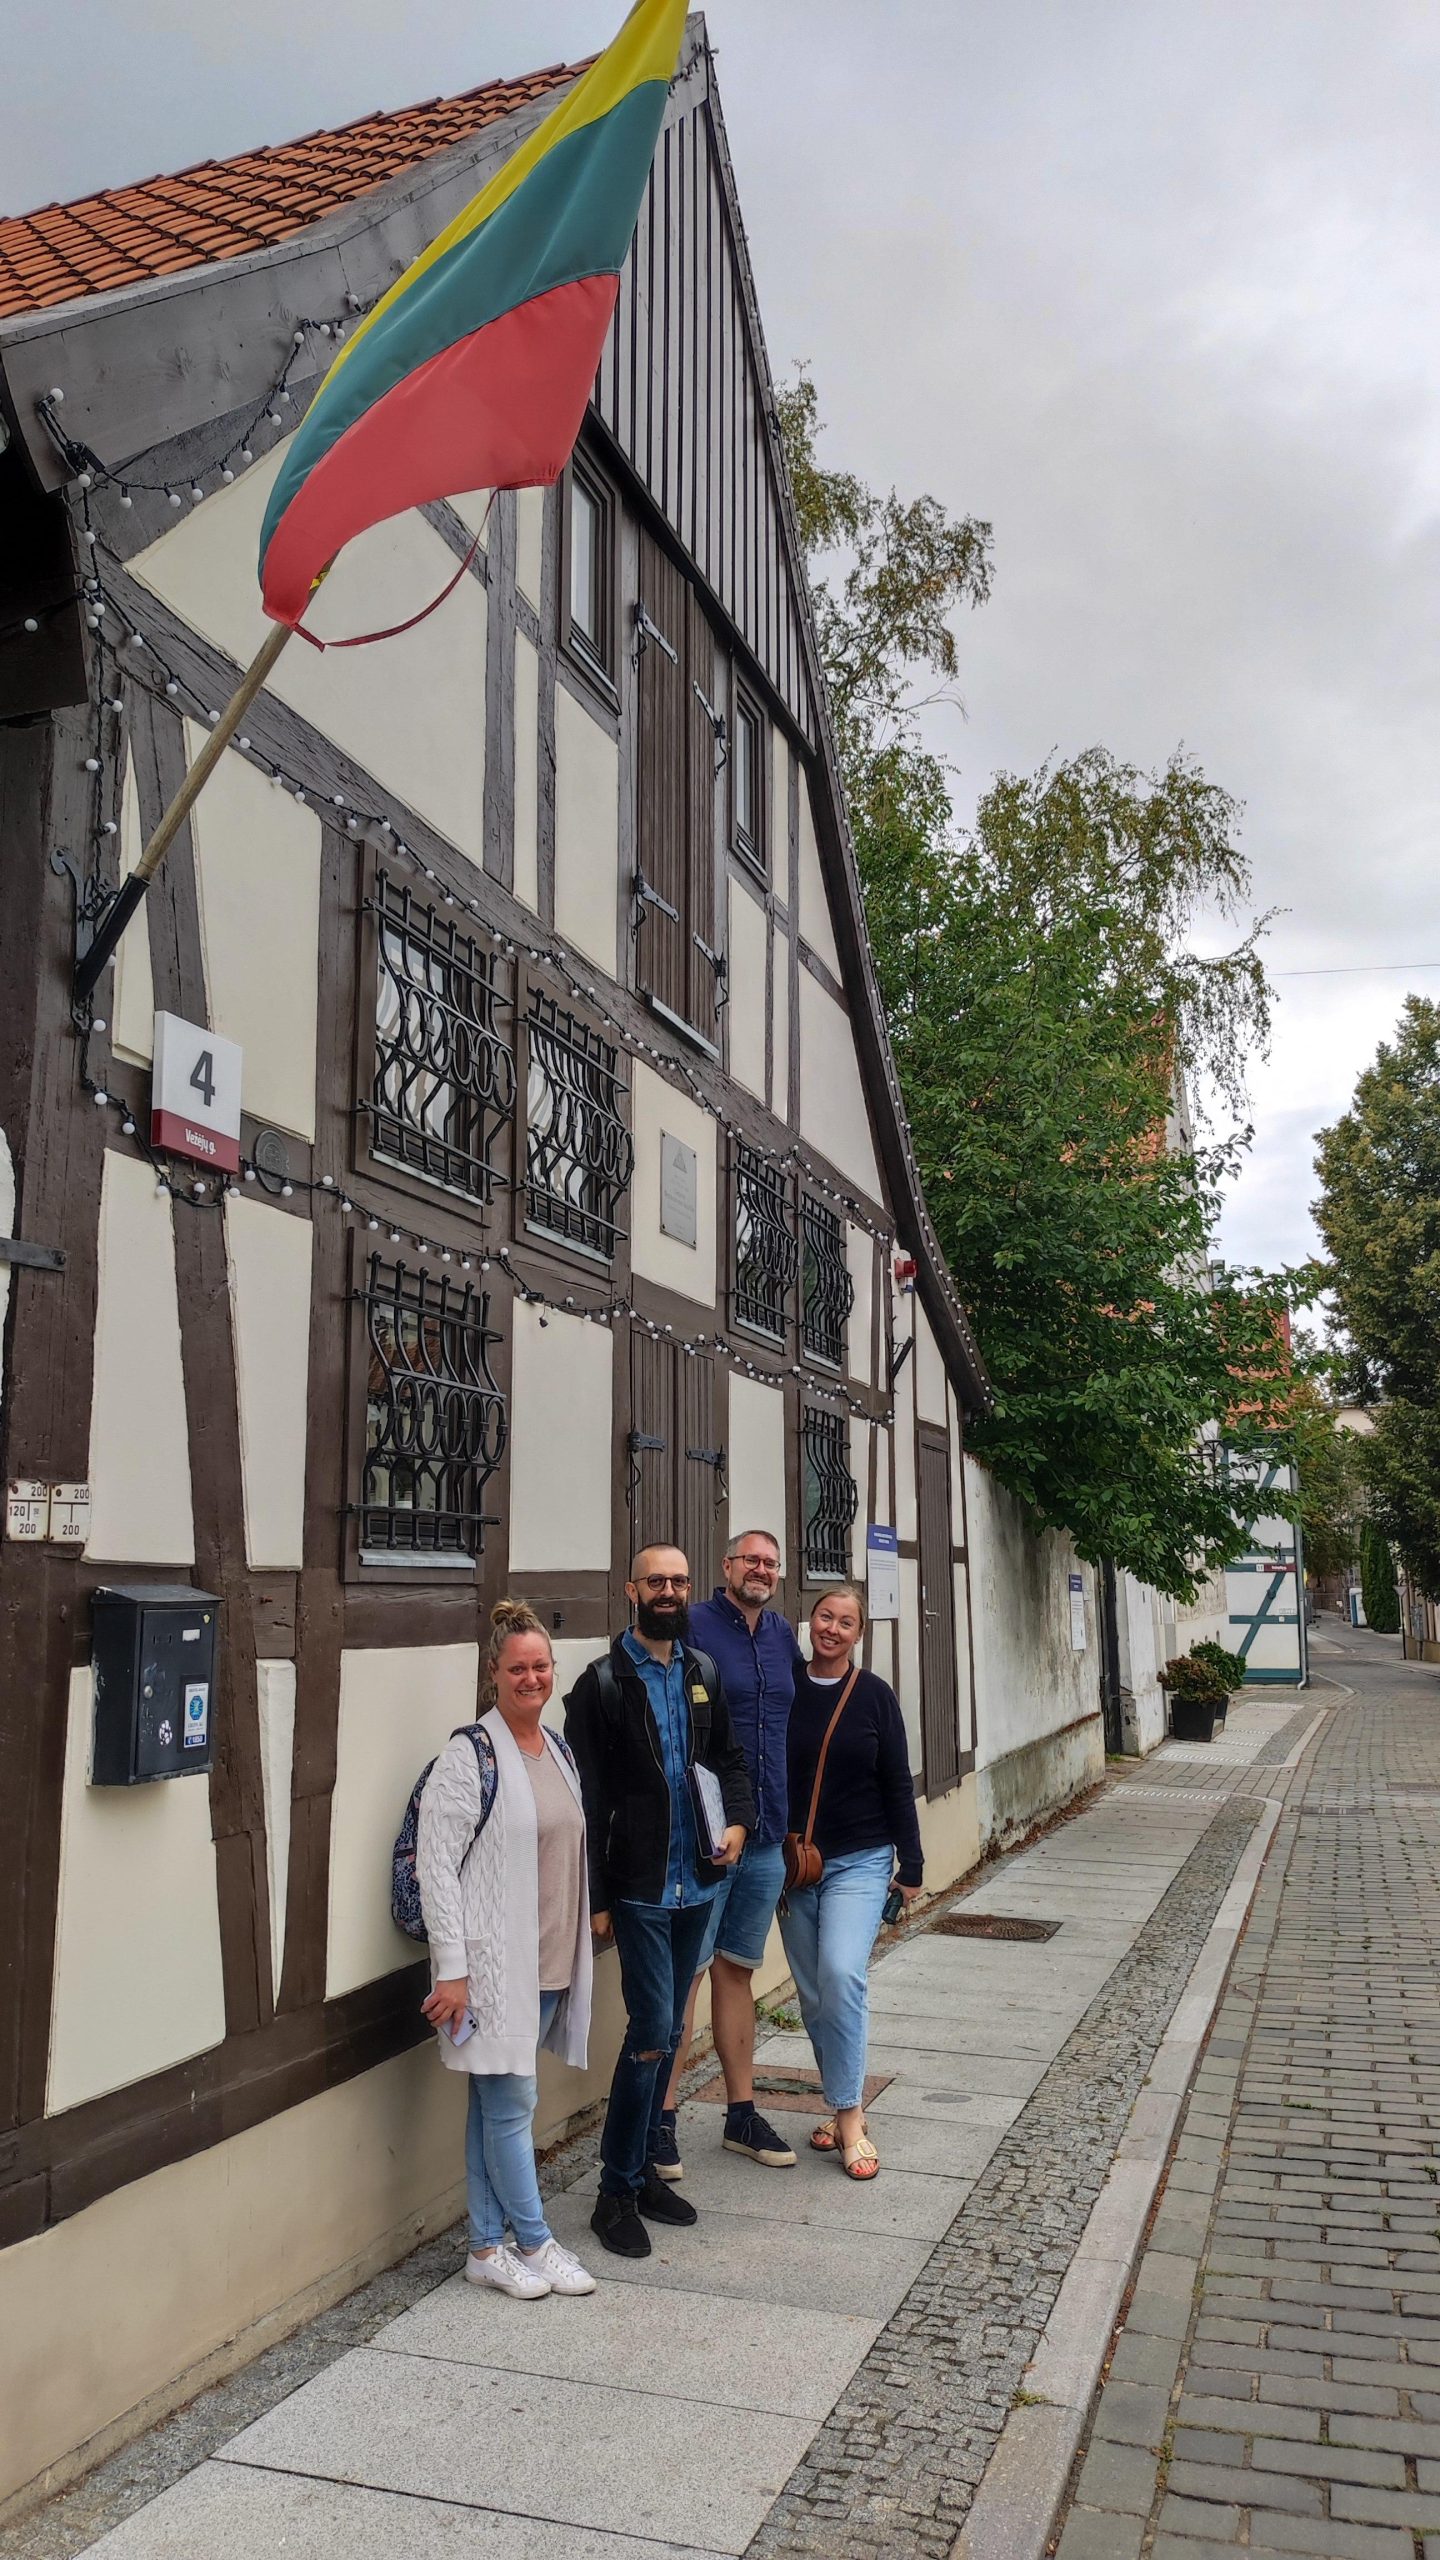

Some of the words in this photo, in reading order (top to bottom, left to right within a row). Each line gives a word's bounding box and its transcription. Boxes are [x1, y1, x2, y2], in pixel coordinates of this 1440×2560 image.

[190, 1050, 215, 1107] 4
[31, 1486, 47, 1497] 200
[74, 1488, 90, 1499] 200
[9, 1505, 25, 1516] 120
[19, 1523, 36, 1534] 200
[62, 1525, 80, 1536] 200
